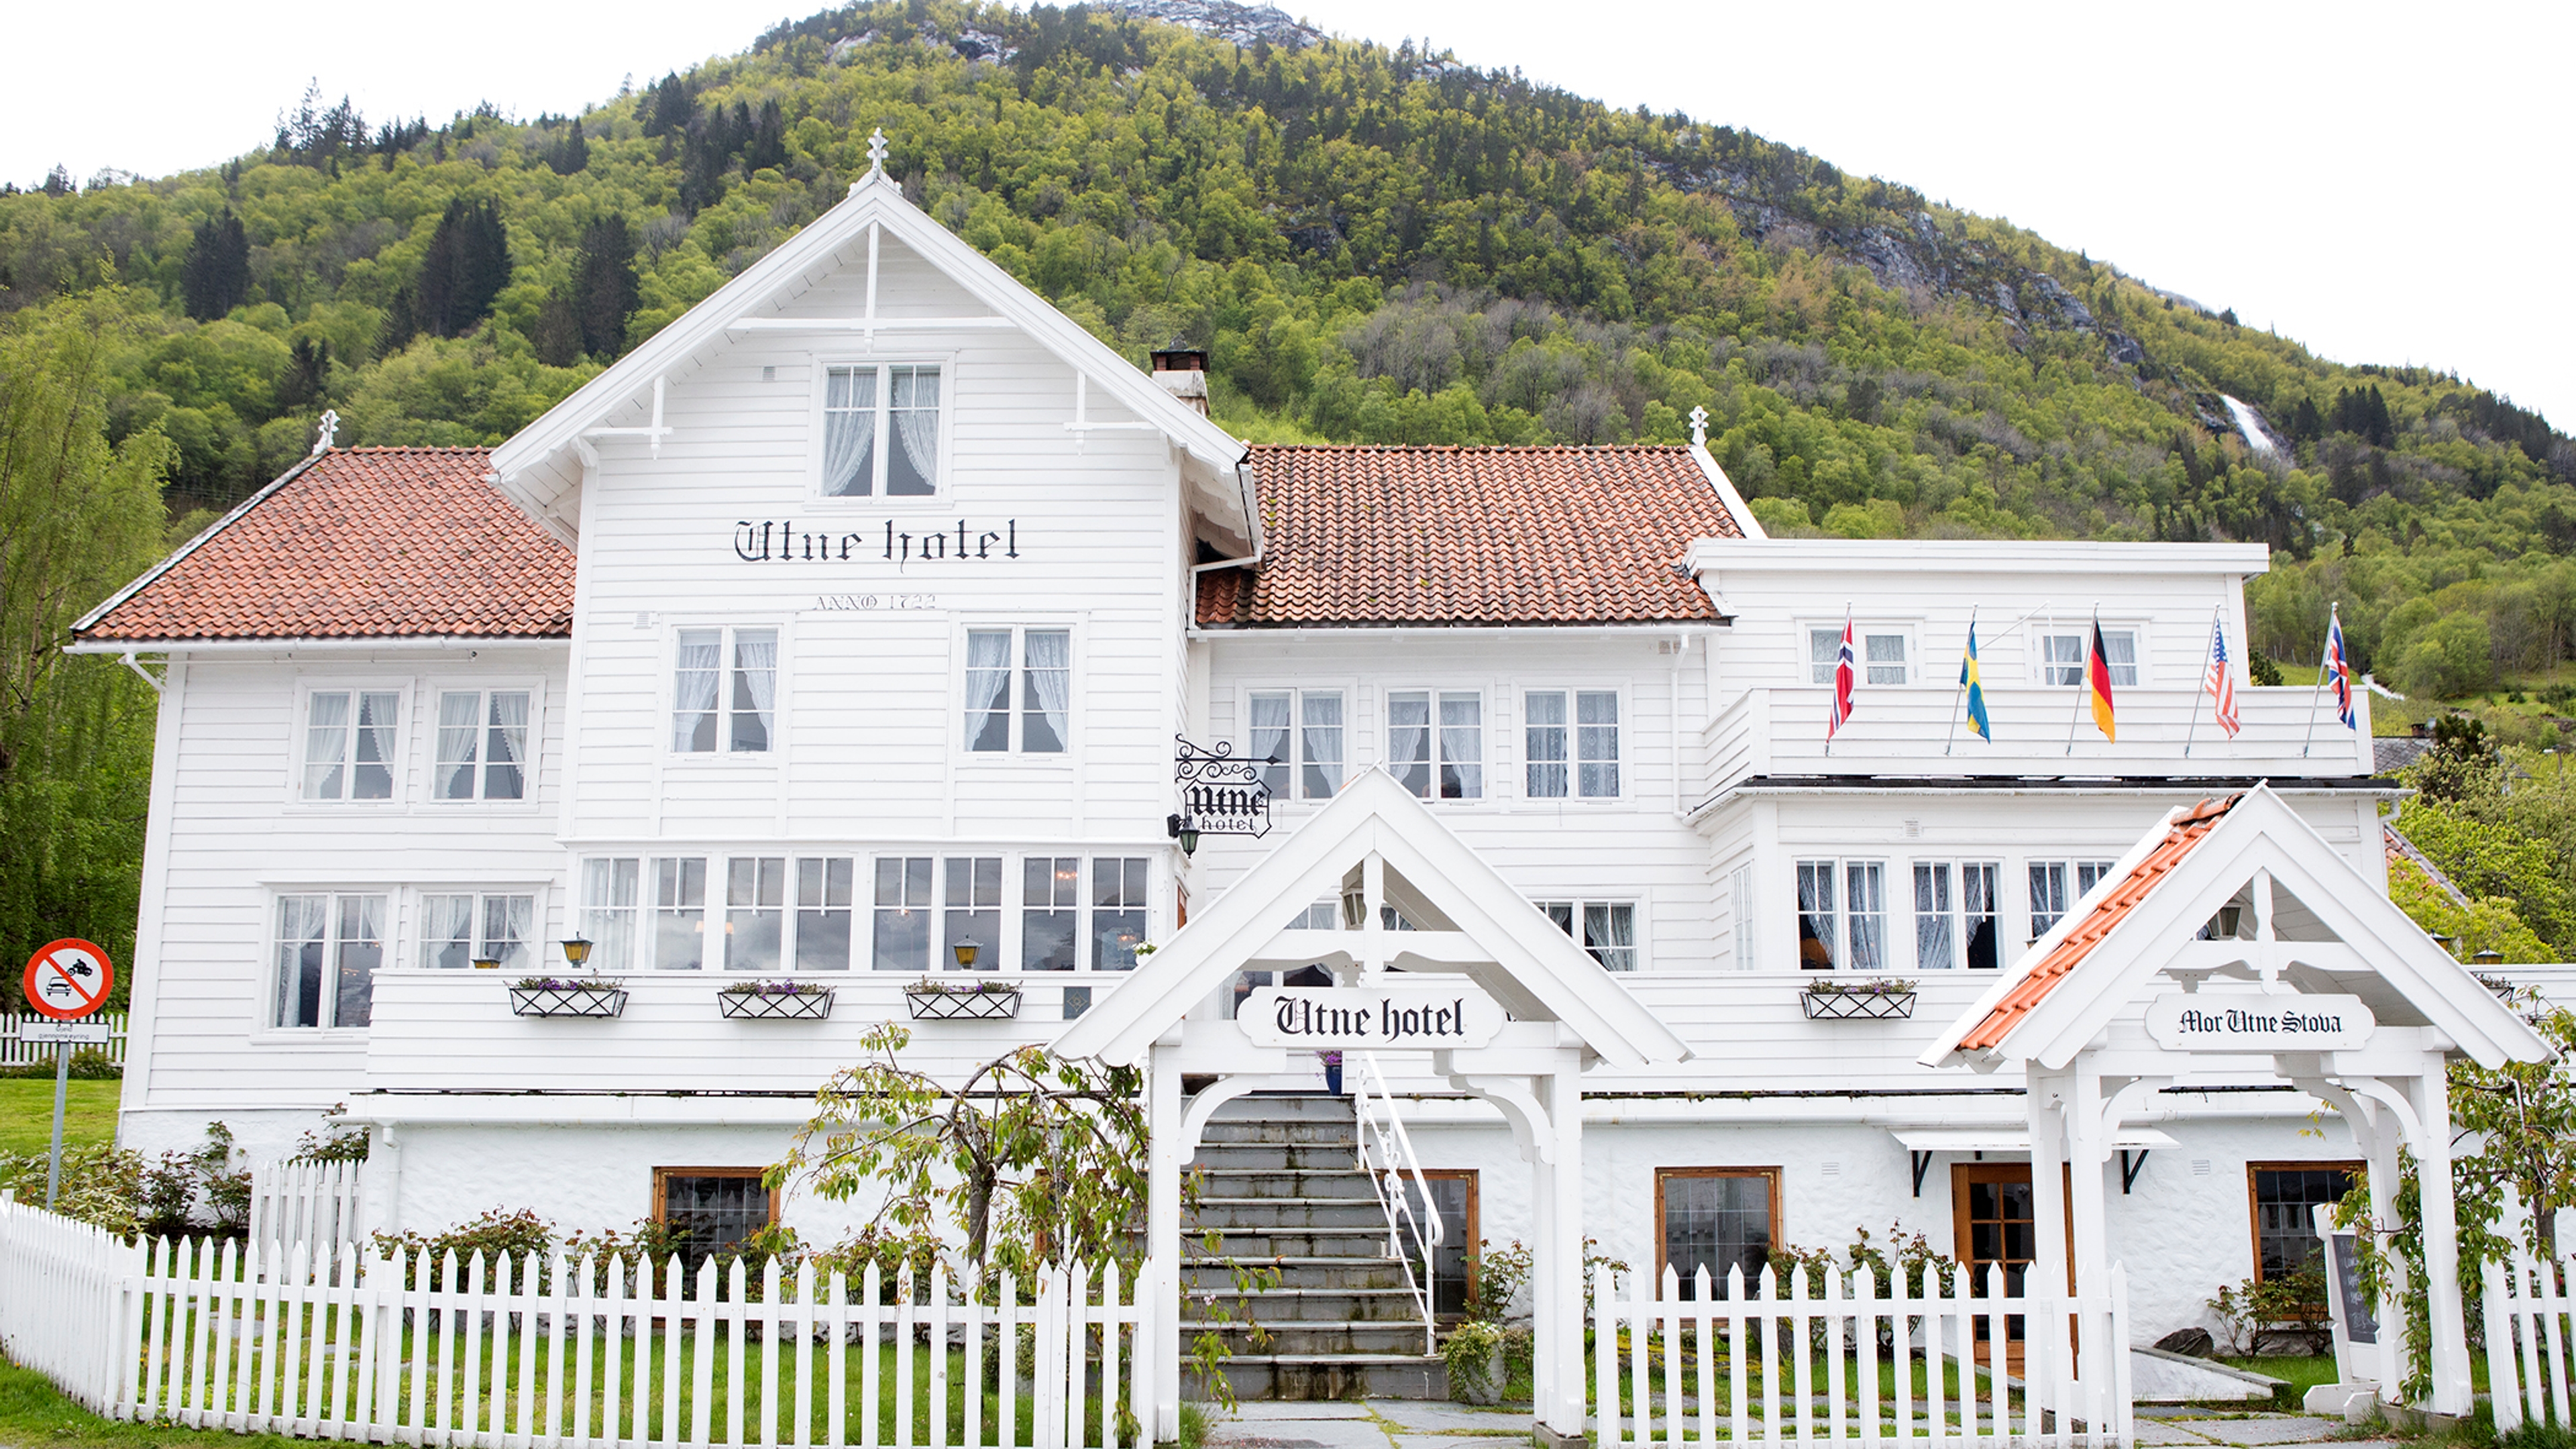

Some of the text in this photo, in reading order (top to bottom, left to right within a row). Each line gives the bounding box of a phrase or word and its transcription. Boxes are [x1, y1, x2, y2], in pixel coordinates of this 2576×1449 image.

[734, 519, 1020, 574] Utne hotel
[812, 594, 936, 610] ANNO 1722
[1200, 815, 1256, 831] hotel
[1274, 995, 1464, 1044] Utne hotel
[2178, 1009, 2343, 1034] Mor Utne Stova
